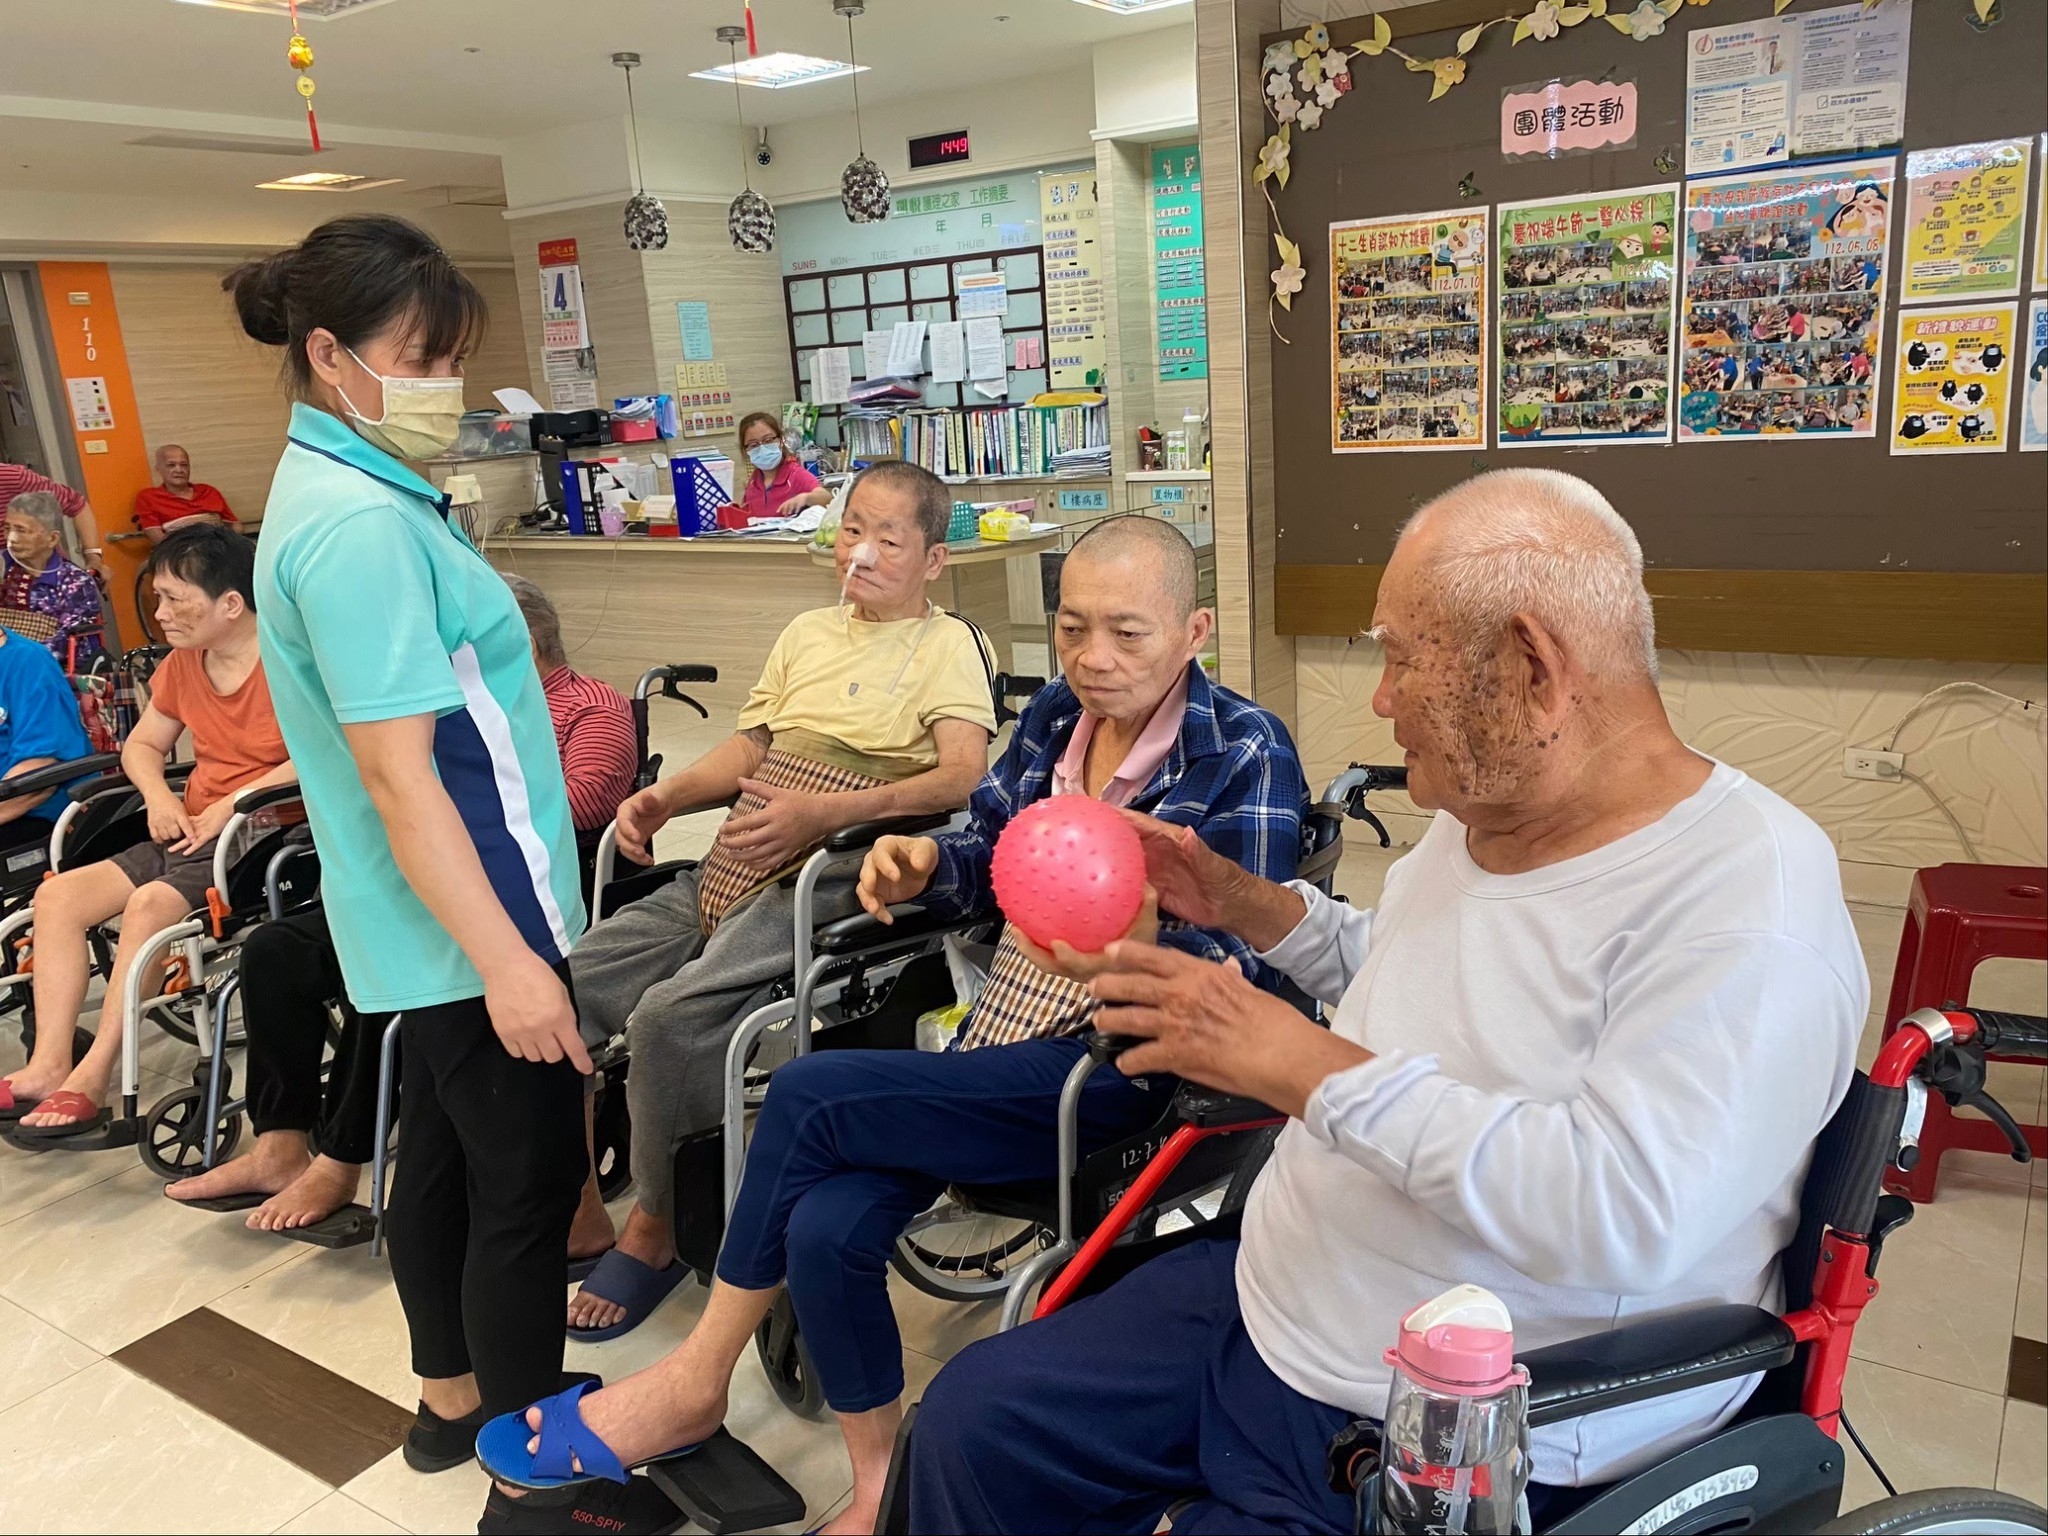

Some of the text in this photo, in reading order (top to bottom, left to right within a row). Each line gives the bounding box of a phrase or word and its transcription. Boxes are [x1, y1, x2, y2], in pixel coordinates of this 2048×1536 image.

[1514, 96, 1624, 136] 團體活動
[941, 137, 967, 155] 1449
[936, 213, 992, 233] 年 月
[1824, 239, 1879, 255] 112.05.08
[553, 272, 567, 311] 4
[82, 317, 97, 362] 110
